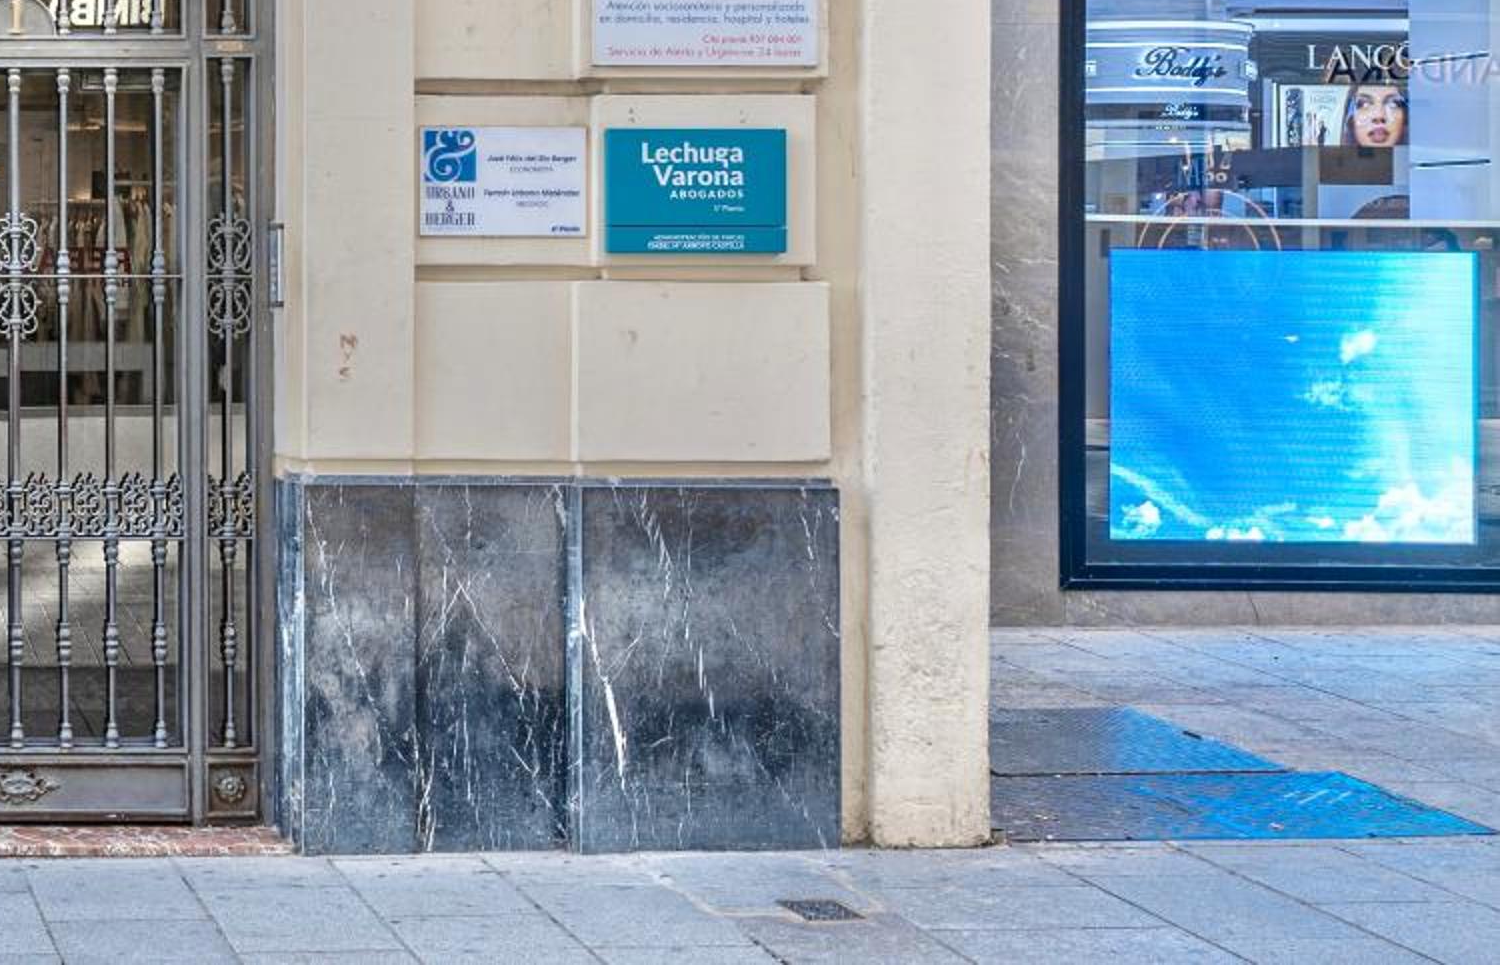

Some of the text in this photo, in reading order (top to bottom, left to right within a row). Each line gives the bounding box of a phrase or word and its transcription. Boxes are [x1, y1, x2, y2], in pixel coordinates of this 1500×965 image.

[641, 141, 744, 168] Lechuga
[652, 165, 744, 186] Varona
[669, 189, 744, 199] ABOGADOS
